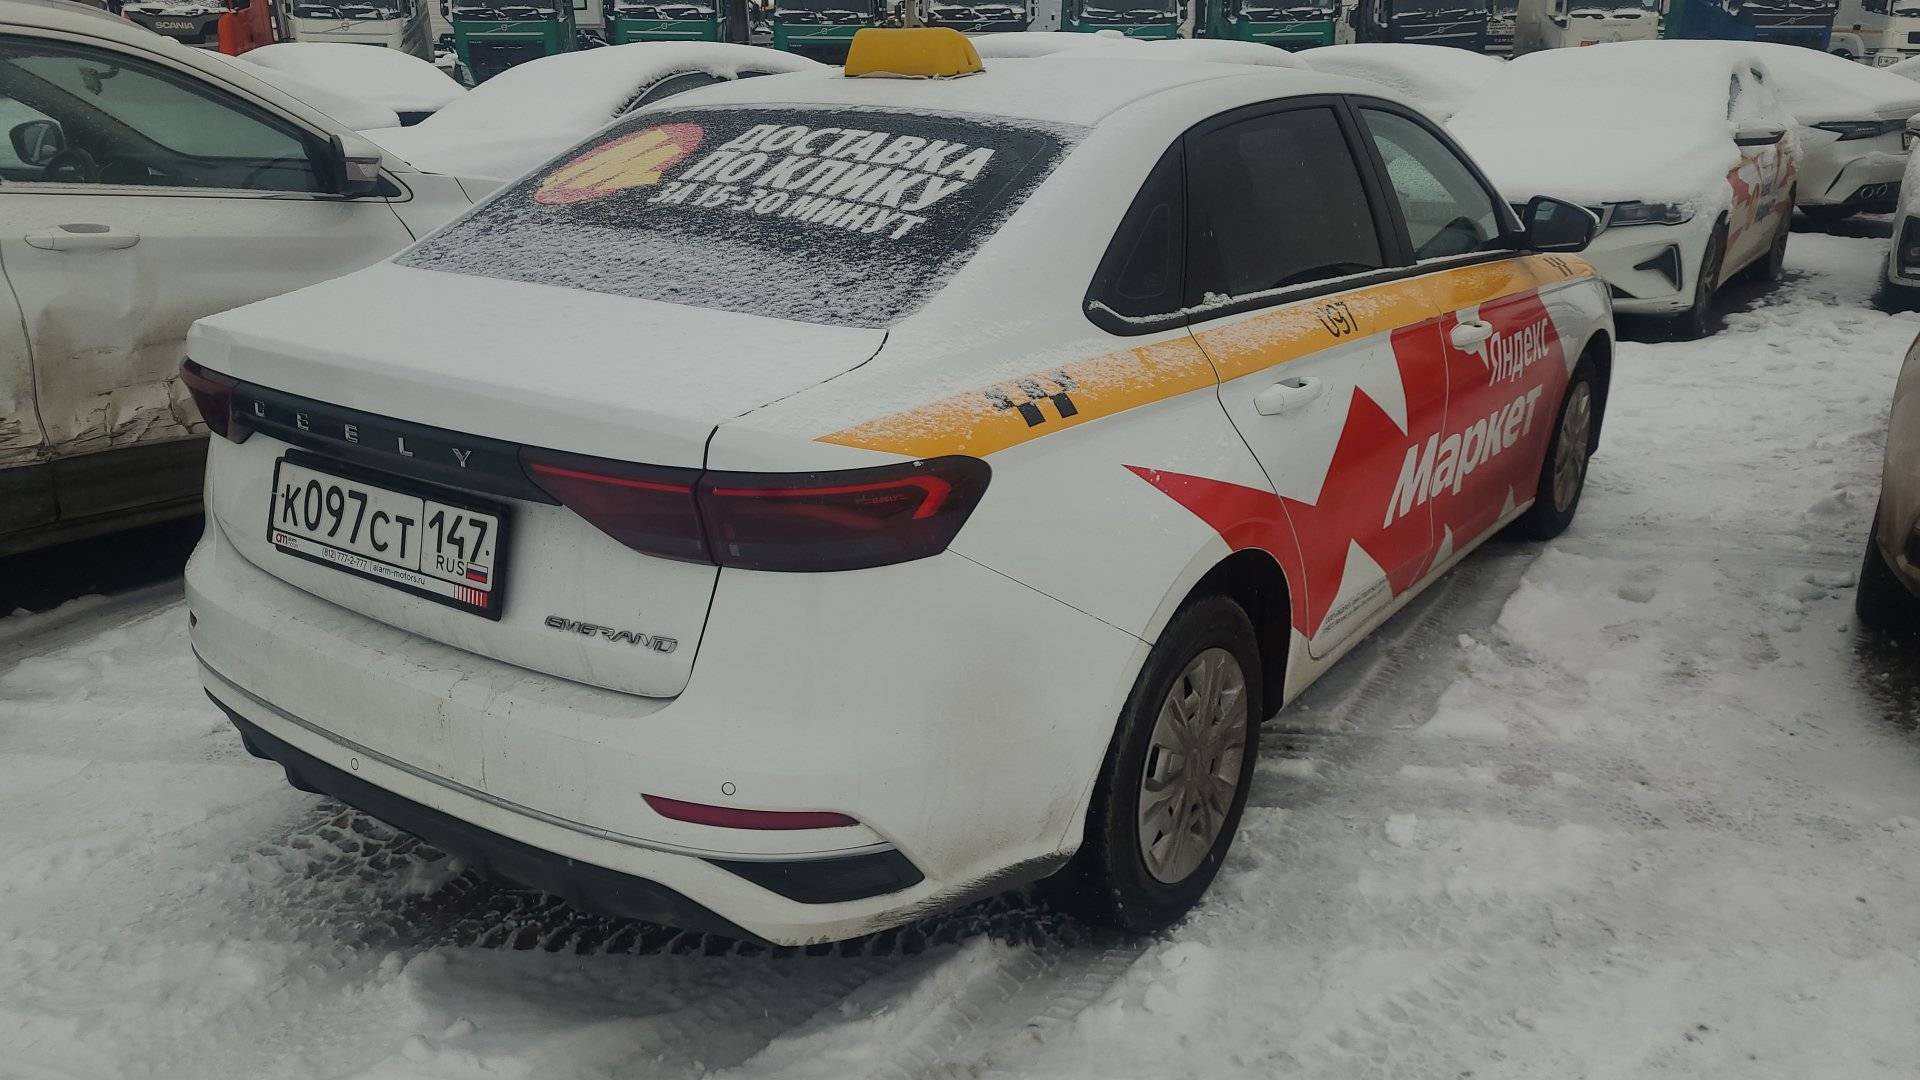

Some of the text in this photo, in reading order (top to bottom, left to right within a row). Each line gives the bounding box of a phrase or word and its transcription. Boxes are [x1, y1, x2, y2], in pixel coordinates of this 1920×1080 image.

[155, 21, 195, 30] SCANIA
[677, 150, 968, 212] ПО КЛИКУ
[716, 124, 996, 181] ДОСТАВКА
[650, 181, 699, 205] ЗА
[779, 195, 927, 240] МИНУТ
[1489, 319, 1550, 387] Яндекс
[1384, 384, 1543, 530] Маркет
[428, 510, 488, 562] 147
[436, 554, 465, 577] RUS
[544, 615, 678, 653] EMGRAND
